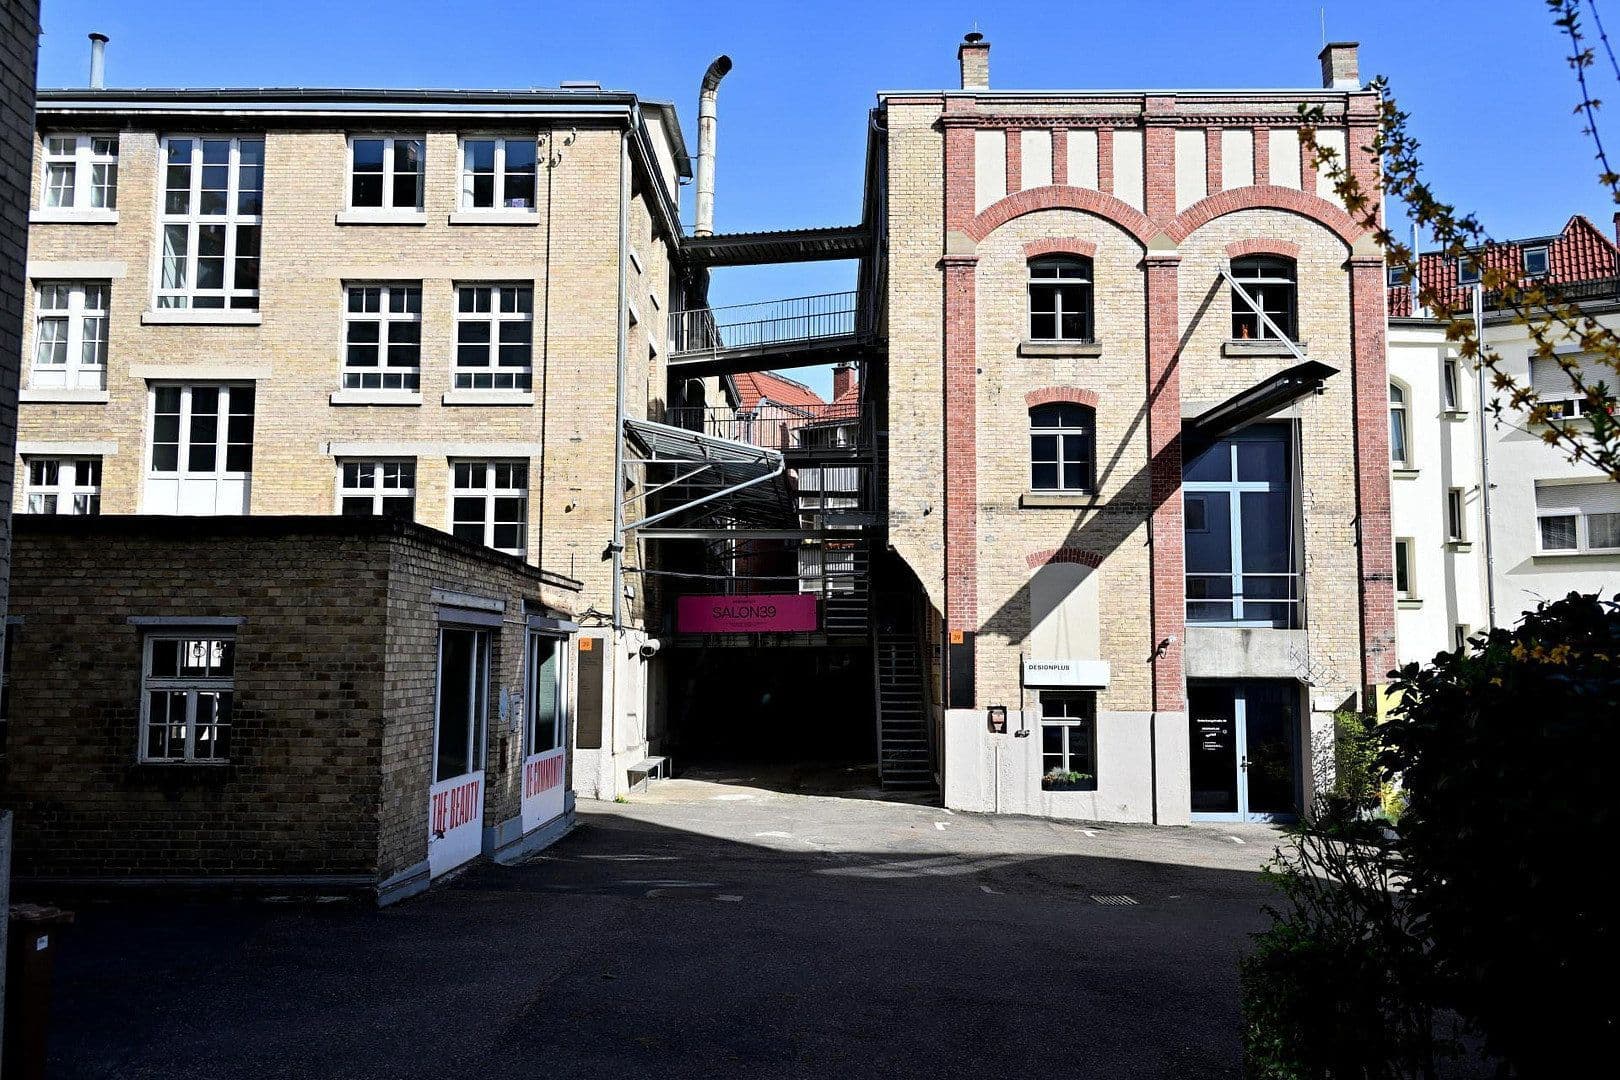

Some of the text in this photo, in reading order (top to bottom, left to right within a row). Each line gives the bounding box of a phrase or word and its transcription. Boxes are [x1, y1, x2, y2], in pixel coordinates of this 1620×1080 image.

[712, 605, 777, 619] SALON39
[432, 780, 480, 835] THE BEAUTY
